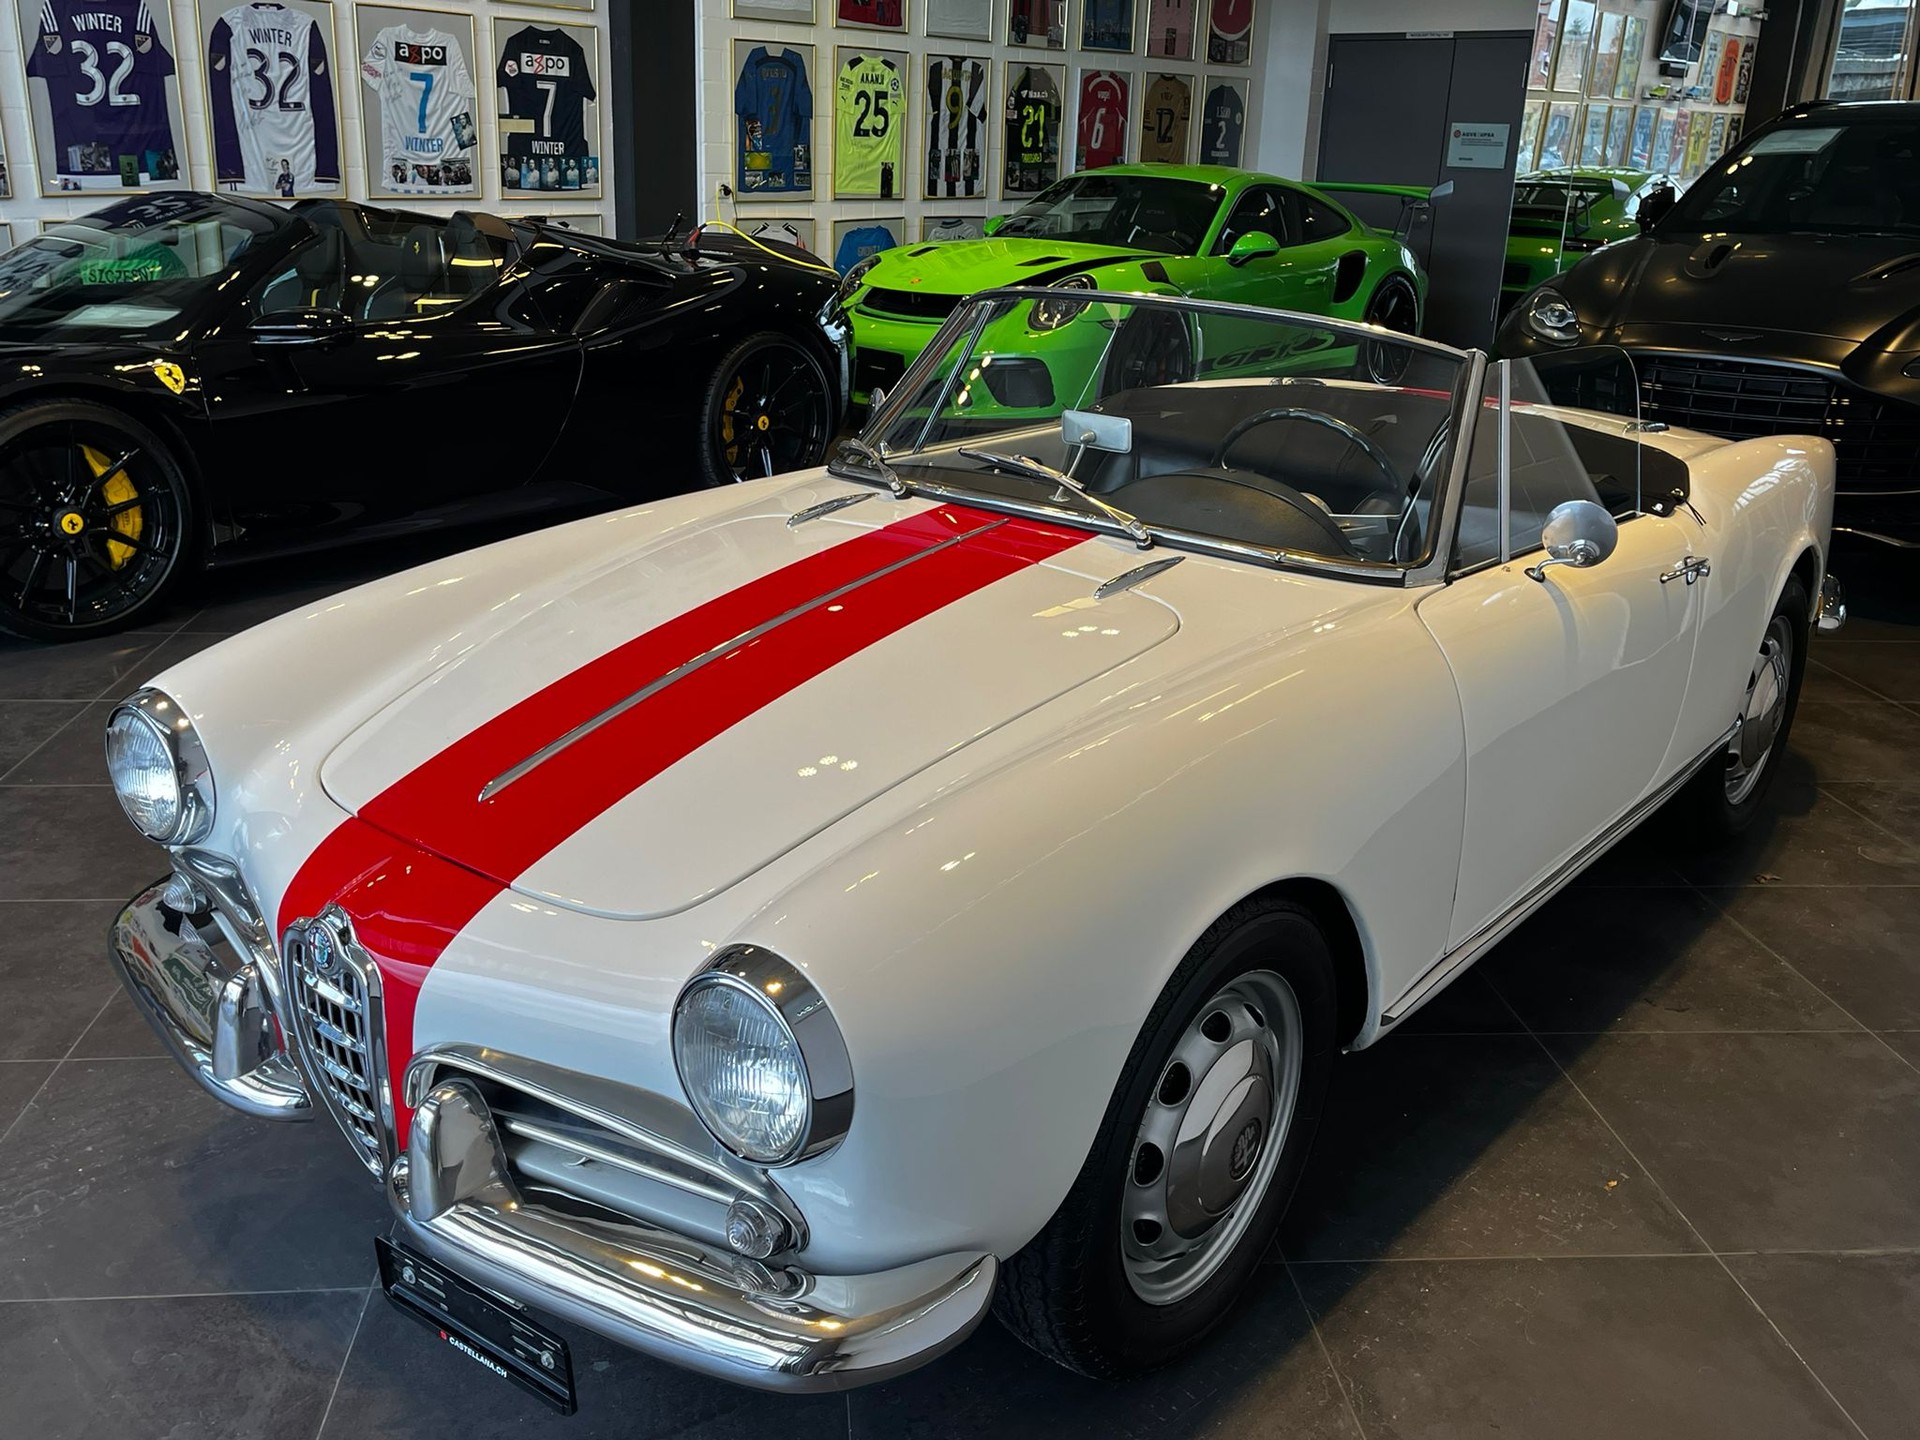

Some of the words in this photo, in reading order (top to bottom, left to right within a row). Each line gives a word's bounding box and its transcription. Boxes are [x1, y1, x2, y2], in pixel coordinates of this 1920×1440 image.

[71, 12, 123, 33] WINTER
[249, 28, 292, 48] WINTER
[70, 39, 141, 107] 32
[246, 48, 306, 112] 32
[860, 72, 885, 86] AKANJI
[410, 72, 433, 134] 7
[536, 80, 557, 138] 7
[853, 89, 889, 138] 25
[945, 85, 964, 130] 9
[405, 135, 444, 152] WINTER
[1021, 104, 1045, 148] 21
[1091, 107, 1106, 150] 6
[1215, 120, 1227, 149] 2
[531, 140, 565, 156] WINTER
[449, 1336, 507, 1378] CASTELLANA.CH
